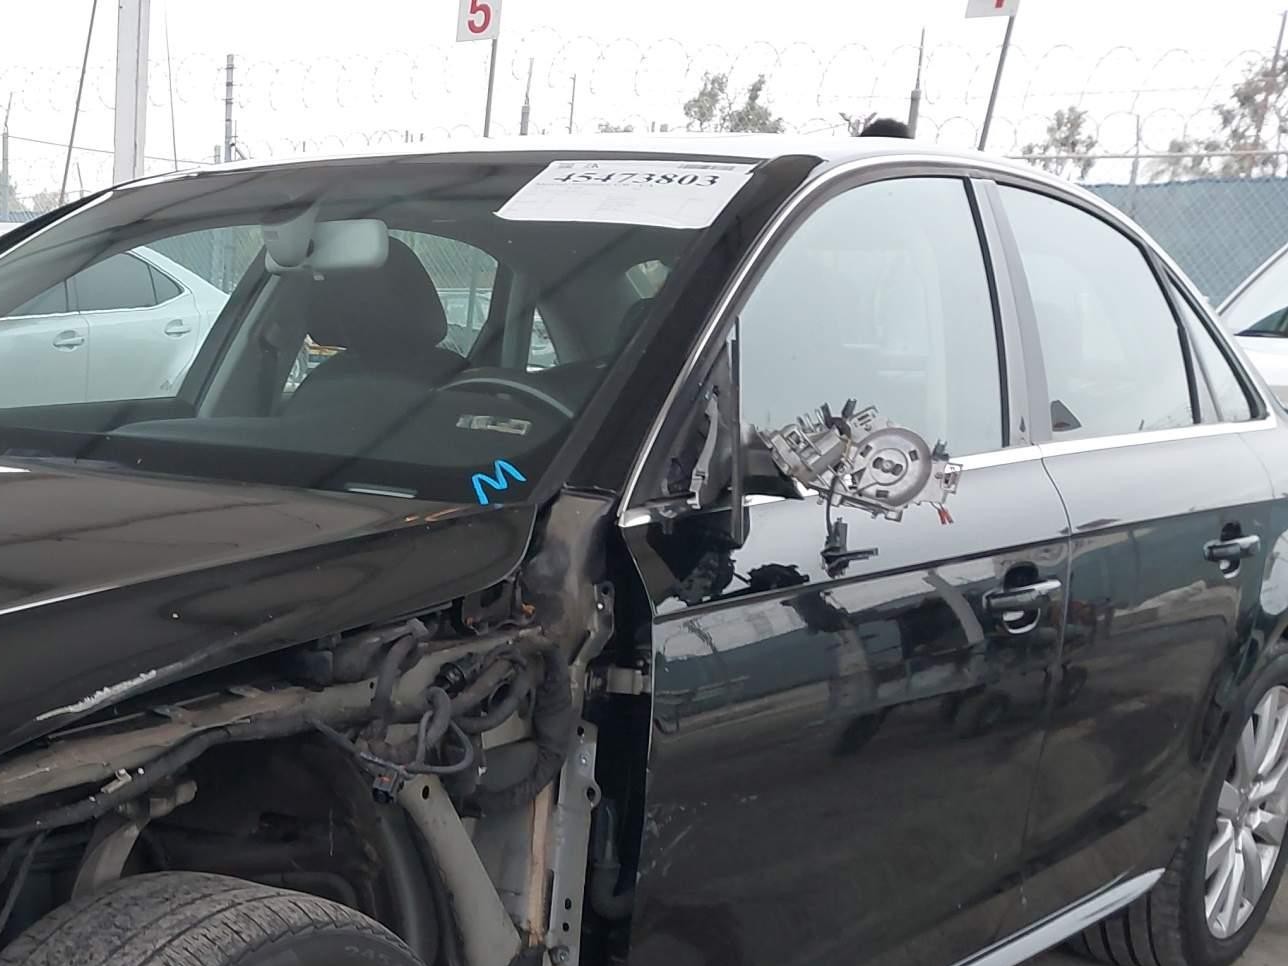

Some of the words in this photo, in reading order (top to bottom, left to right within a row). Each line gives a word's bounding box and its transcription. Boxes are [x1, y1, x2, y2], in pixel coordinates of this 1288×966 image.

[467, 0, 491, 33] 5
[554, 172, 720, 187] 45473803
[472, 459, 527, 505] M
